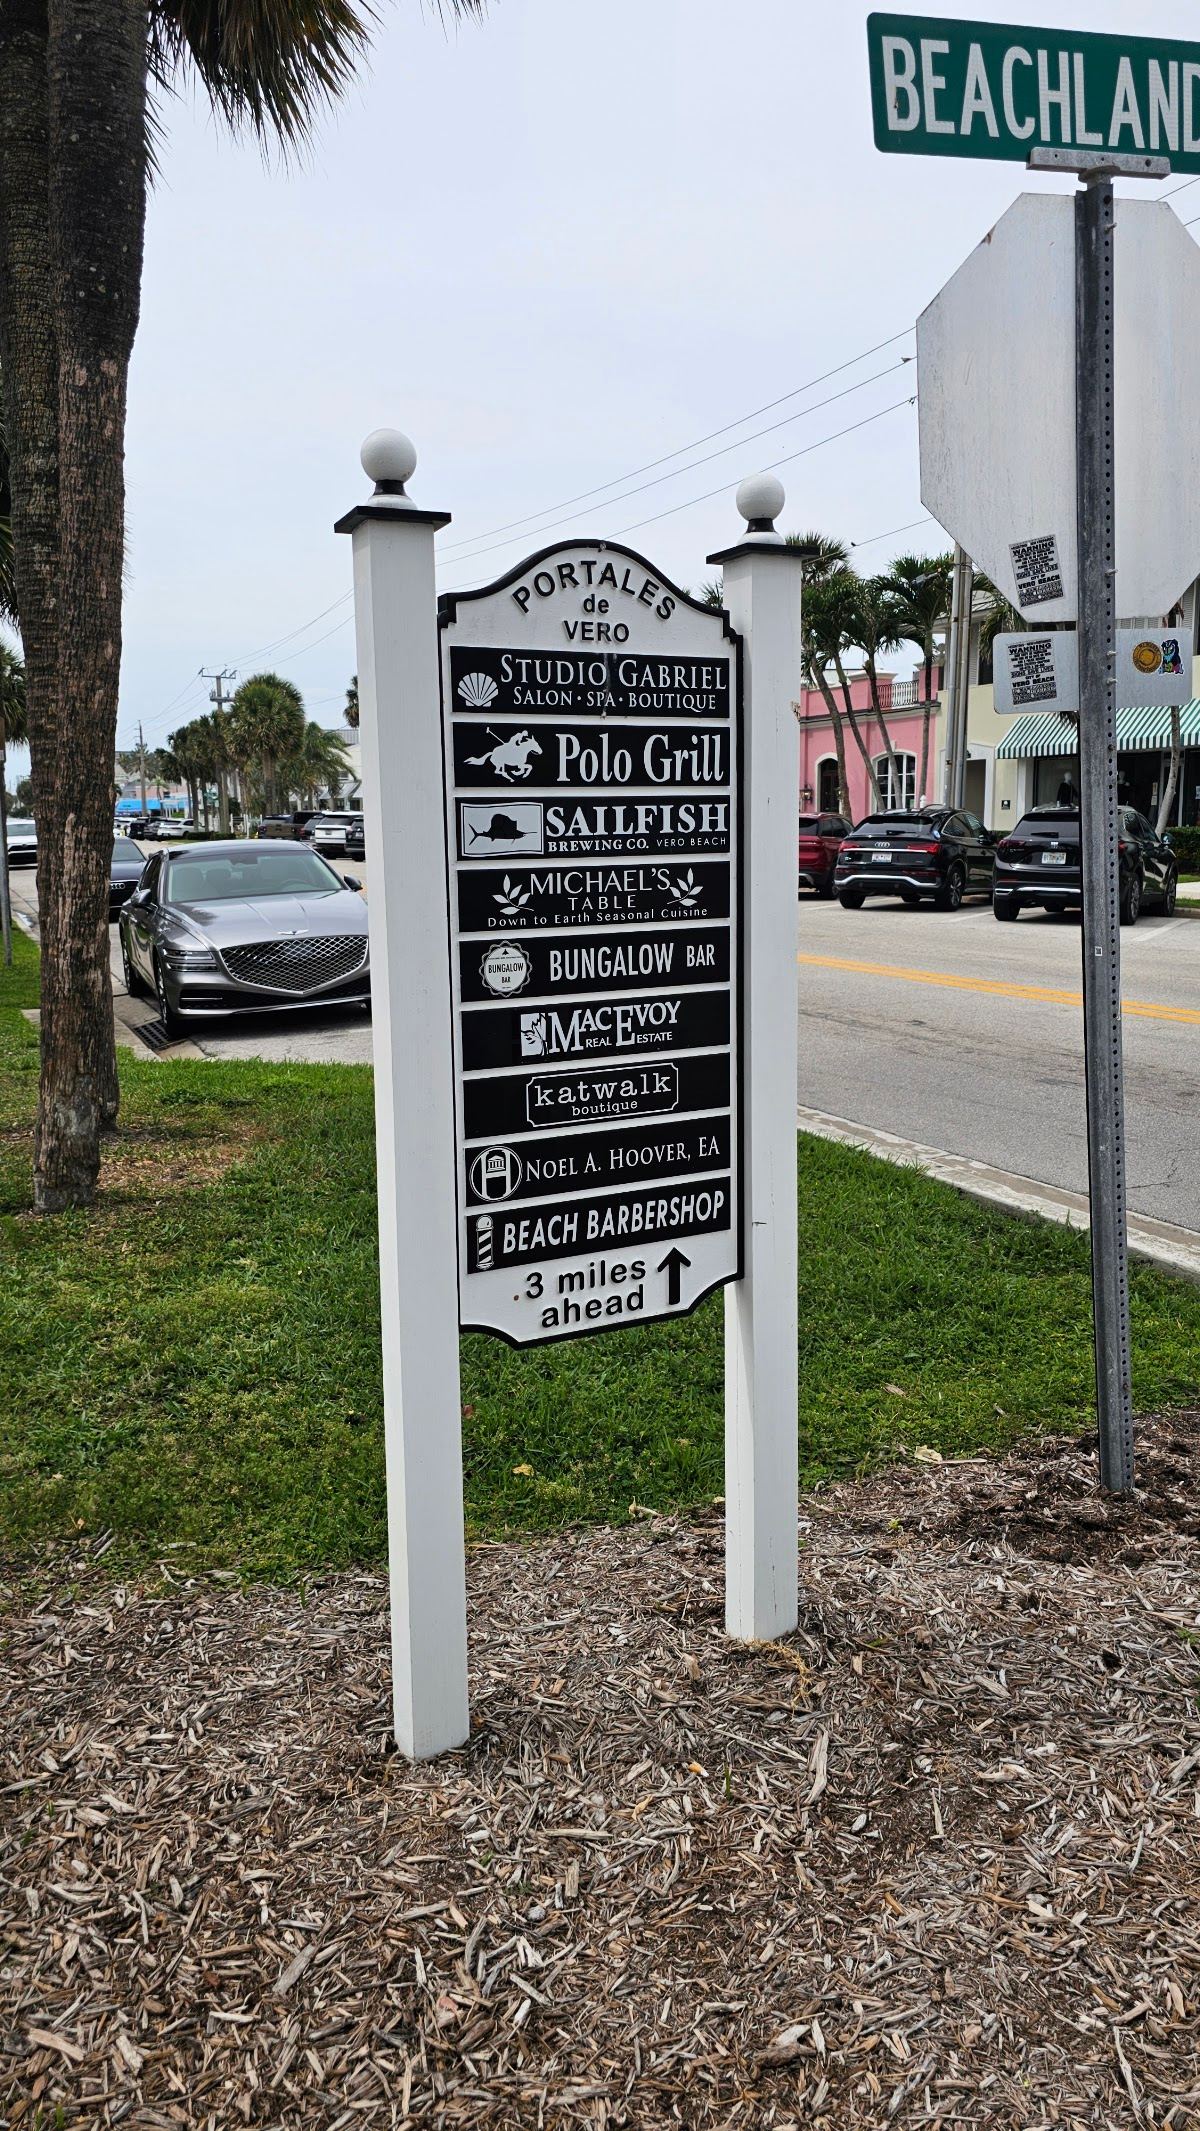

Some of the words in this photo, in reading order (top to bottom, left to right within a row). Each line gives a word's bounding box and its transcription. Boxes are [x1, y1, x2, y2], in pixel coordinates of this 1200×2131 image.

[1012, 541, 1054, 557] WARNING
[511, 560, 676, 620] PORTALES
[1018, 581, 1036, 589] VERO
[1038, 574, 1060, 584] BEACH
[583, 593, 610, 614] de
[563, 620, 630, 642] VERO
[1009, 642, 1052, 655] WARNING
[500, 654, 608, 686] STUDIO
[618, 659, 727, 690] GABRIEL
[1012, 680, 1030, 688] VERO
[1033, 675, 1055, 684] BEACH
[513, 686, 572, 706] SALON
[587, 690, 616, 707] SPA
[628, 692, 716, 712] BOUTIQUE
[556, 733, 632, 783] Polo
[643, 733, 724, 783] Grill
[545, 803, 728, 838] SAILFISH
[547, 839, 623, 852] BREWING
[626, 838, 650, 850] CO.
[656, 838, 685, 847] VERO
[690, 837, 726, 846] BEACH
[530, 868, 671, 896] MICHAEL'S
[568, 894, 637, 911] TABLE
[487, 916, 527, 928] Down
[534, 915, 548, 925] to
[554, 912, 590, 924] Earth
[596, 908, 655, 922] Seasonal
[660, 906, 708, 918] Cuisine
[488, 962, 523, 973] BUNGALOW
[549, 942, 674, 982] BUNGALOW
[686, 944, 716, 968] BAR
[585, 1037, 612, 1048] REAL
[637, 1031, 673, 1044] ESTATE
[534, 1072, 672, 1107] katwalk
[571, 1099, 638, 1117] boutique
[525, 1156, 578, 1182] NOEL
[583, 1152, 602, 1174] A.
[609, 1141, 691, 1170] HOOVER,
[698, 1135, 720, 1157] EA
[503, 1212, 579, 1254] BEACH
[586, 1190, 725, 1241] BARBERSHOP
[525, 1271, 544, 1299] 3
[558, 1259, 646, 1294] miles
[541, 1283, 644, 1328] ahead
